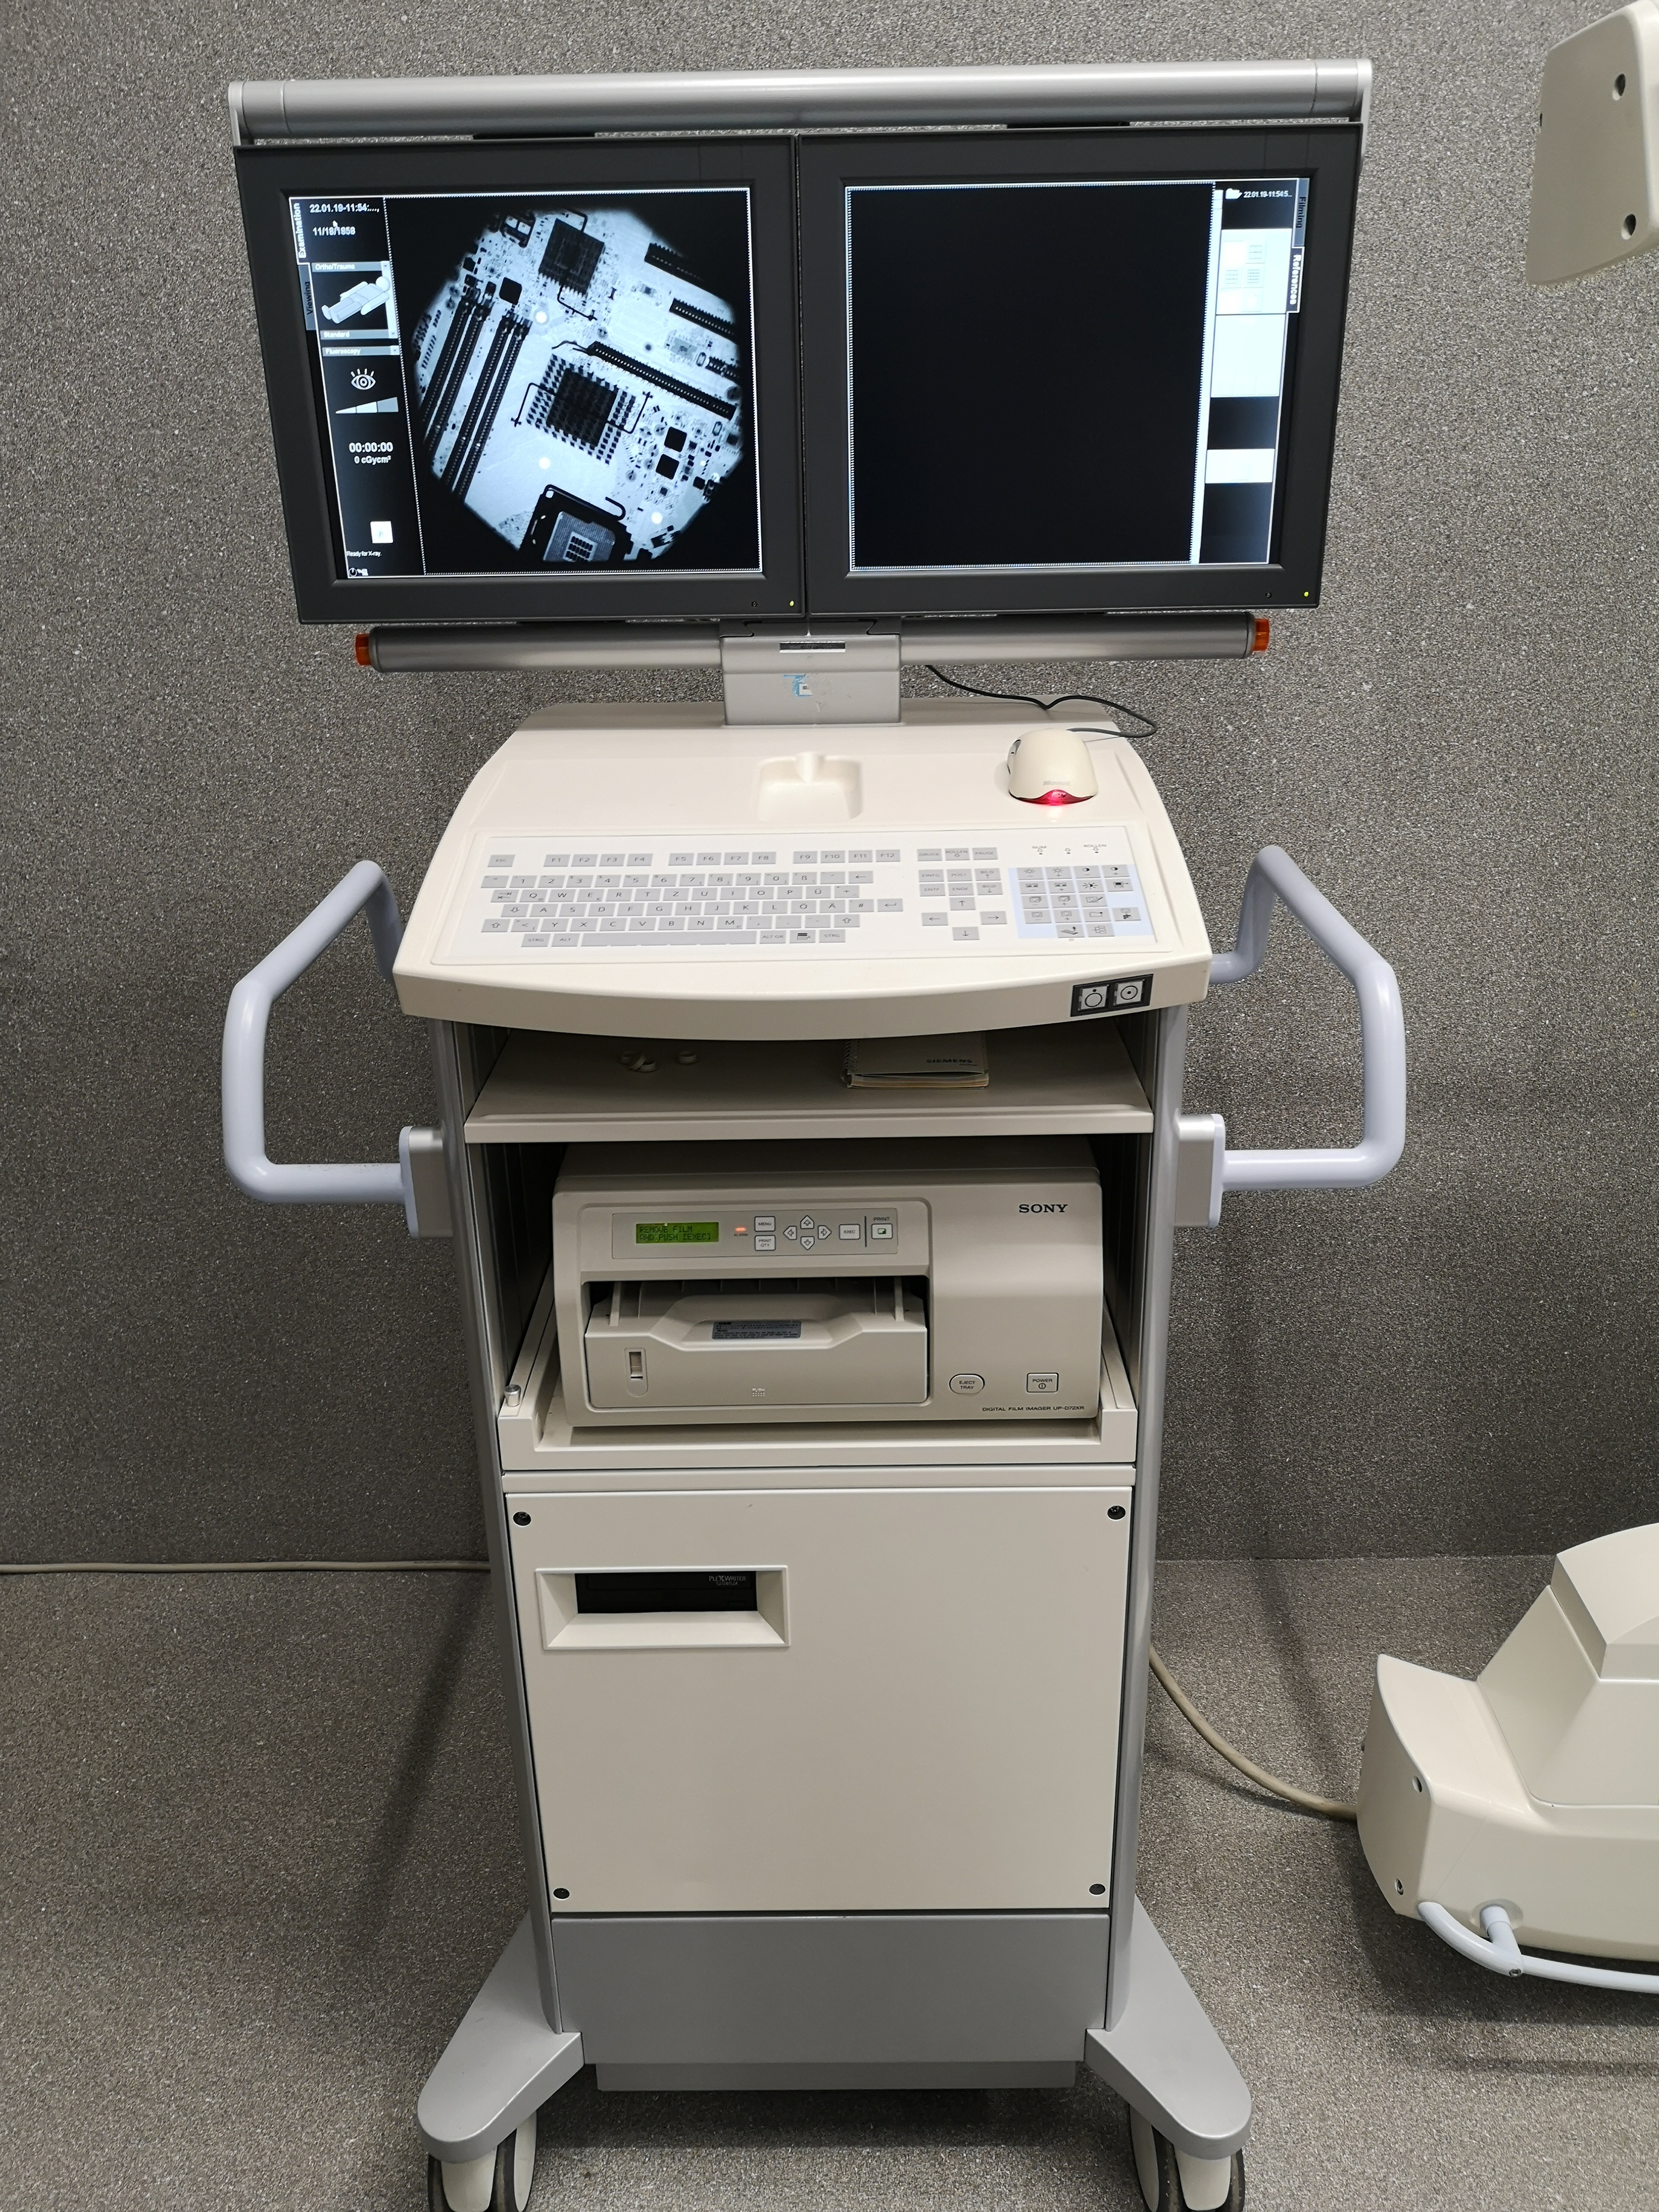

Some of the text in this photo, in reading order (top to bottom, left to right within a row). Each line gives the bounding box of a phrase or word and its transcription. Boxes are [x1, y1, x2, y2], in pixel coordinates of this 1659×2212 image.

[293, 202, 307, 258] Examination
[1290, 254, 1301, 305] References
[349, 442, 394, 453] 00:00:00
[354, 455, 360, 464] 0
[1019, 1204, 1068, 1213] SONY
